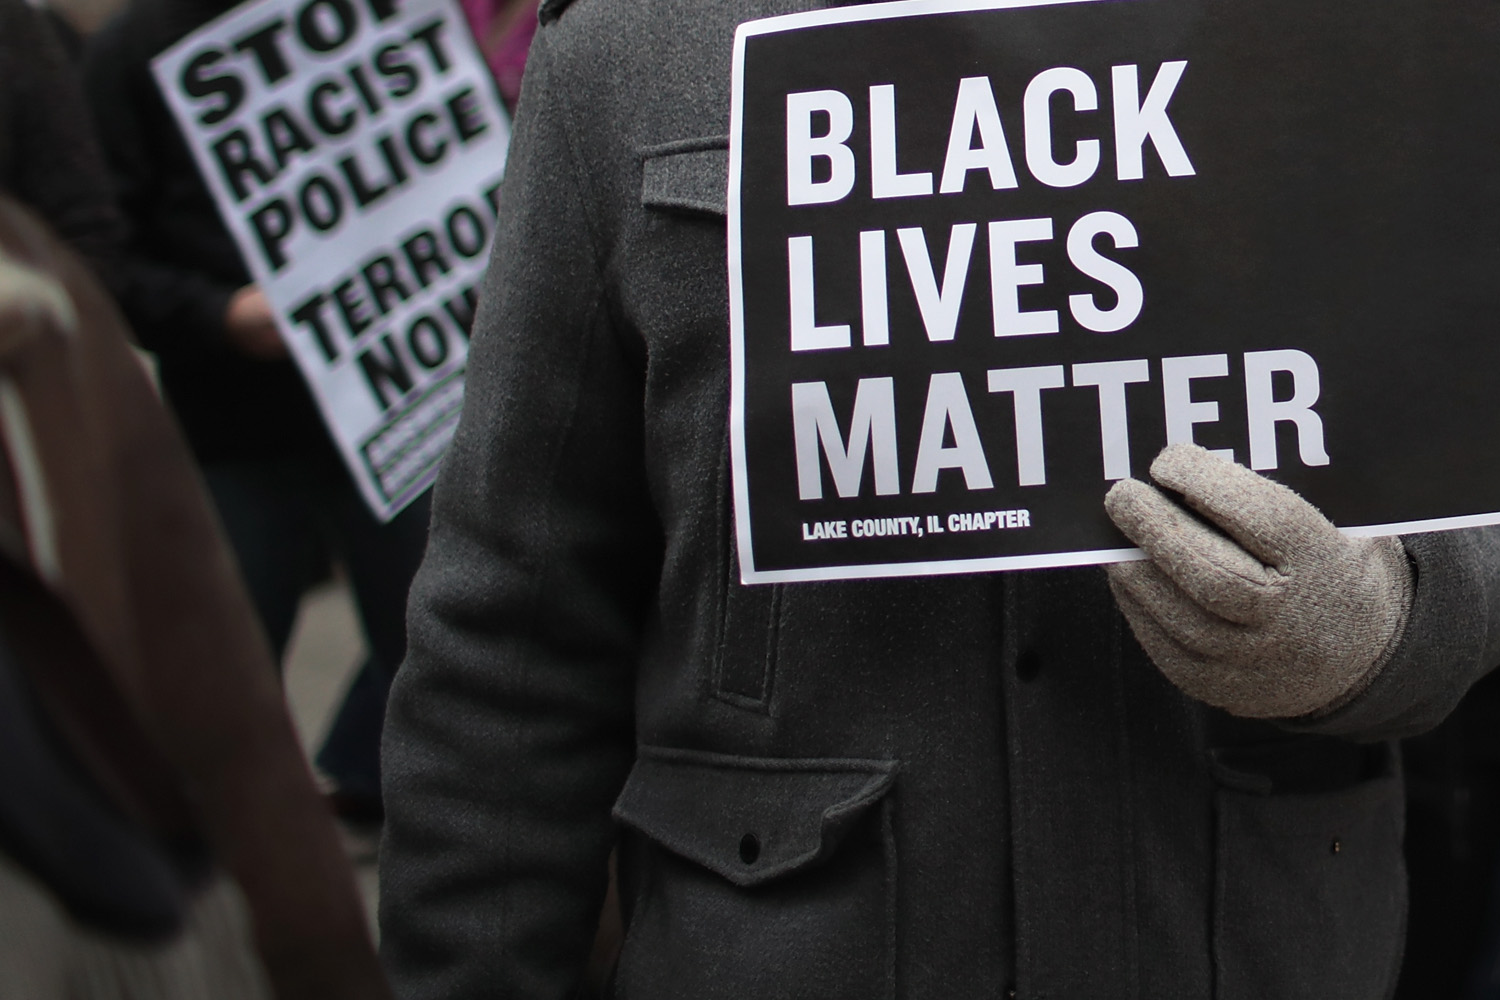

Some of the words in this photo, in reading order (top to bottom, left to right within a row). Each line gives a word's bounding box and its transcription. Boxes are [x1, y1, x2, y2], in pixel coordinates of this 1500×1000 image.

[212, 18, 452, 206] RACIST
[248, 87, 490, 272] POLICE
[786, 60, 1197, 207] BLACK
[290, 185, 500, 363] TERRO
[788, 210, 1145, 353] LIVES
[791, 348, 1331, 501] MATTER
[802, 521, 848, 541] LAKE
[851, 516, 922, 538] COUNTY,
[926, 515, 944, 533] IL
[947, 508, 1031, 532] CHAPTER
